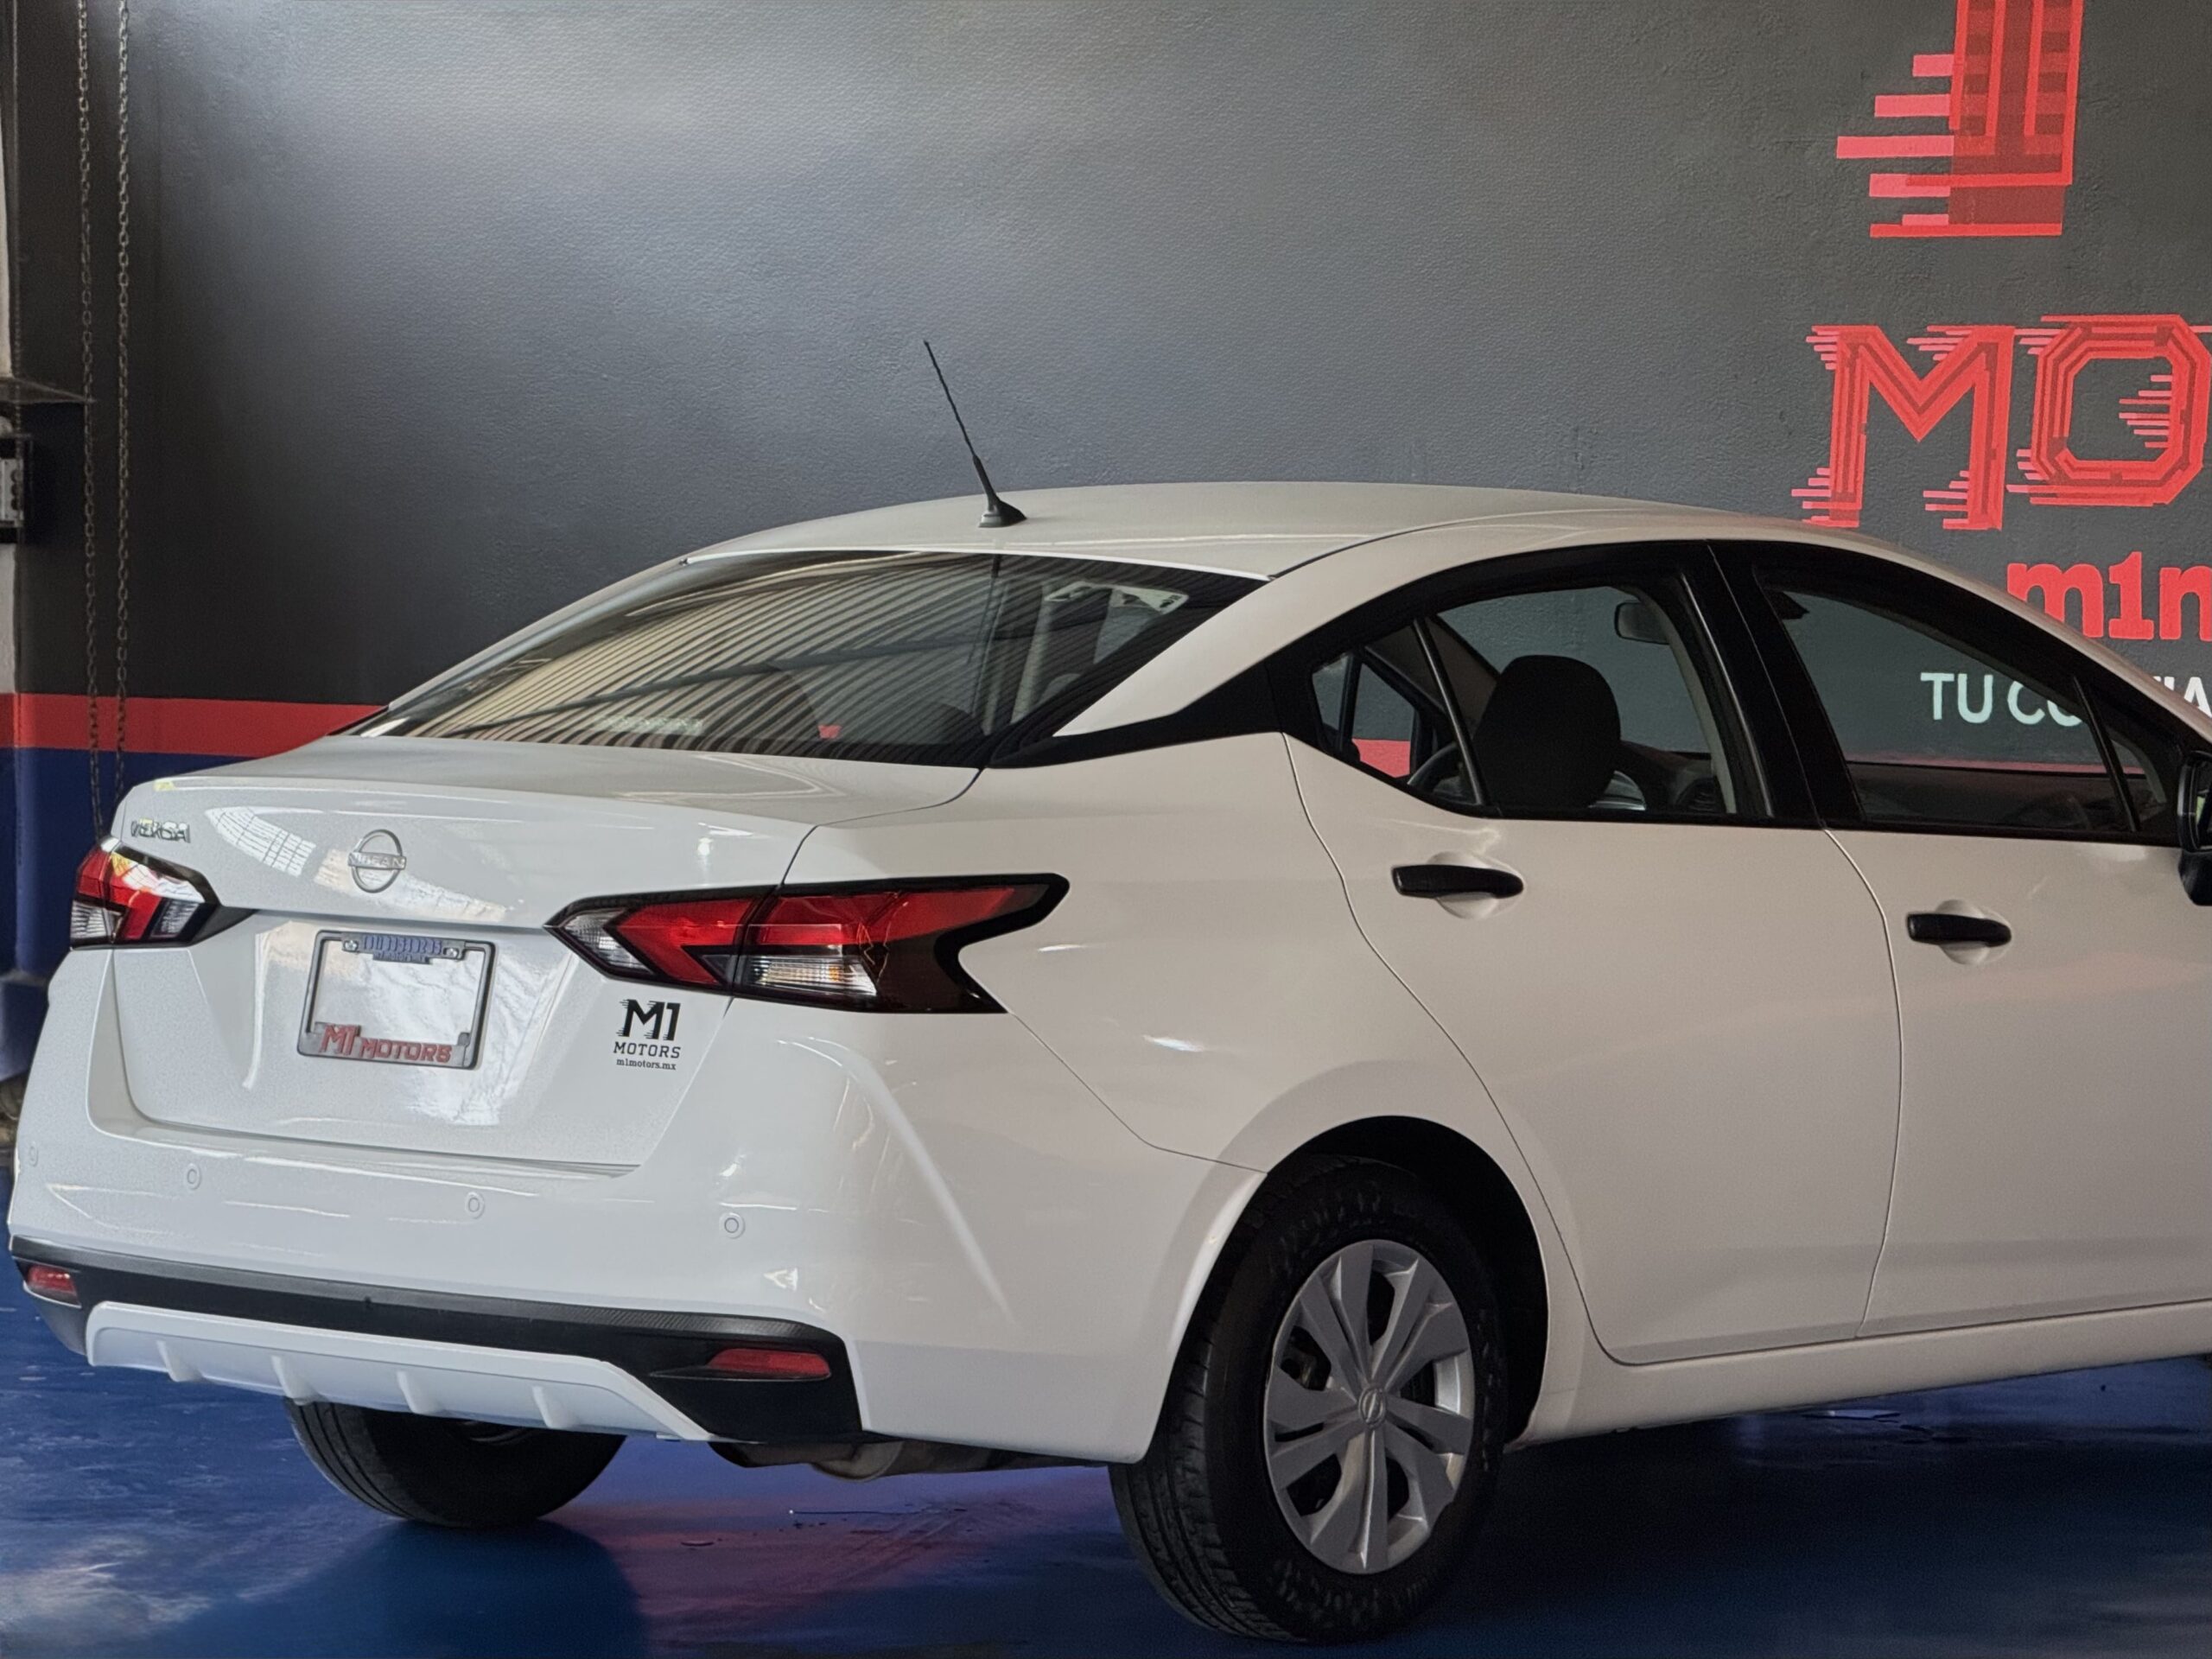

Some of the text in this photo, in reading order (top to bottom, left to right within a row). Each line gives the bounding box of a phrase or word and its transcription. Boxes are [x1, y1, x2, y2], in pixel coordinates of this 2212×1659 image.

[1920, 672, 1993, 724] TU
[615, 999, 681, 1041] M1
[359, 1038, 453, 1064] MOTORS
[613, 1041, 681, 1058] MOTORS
